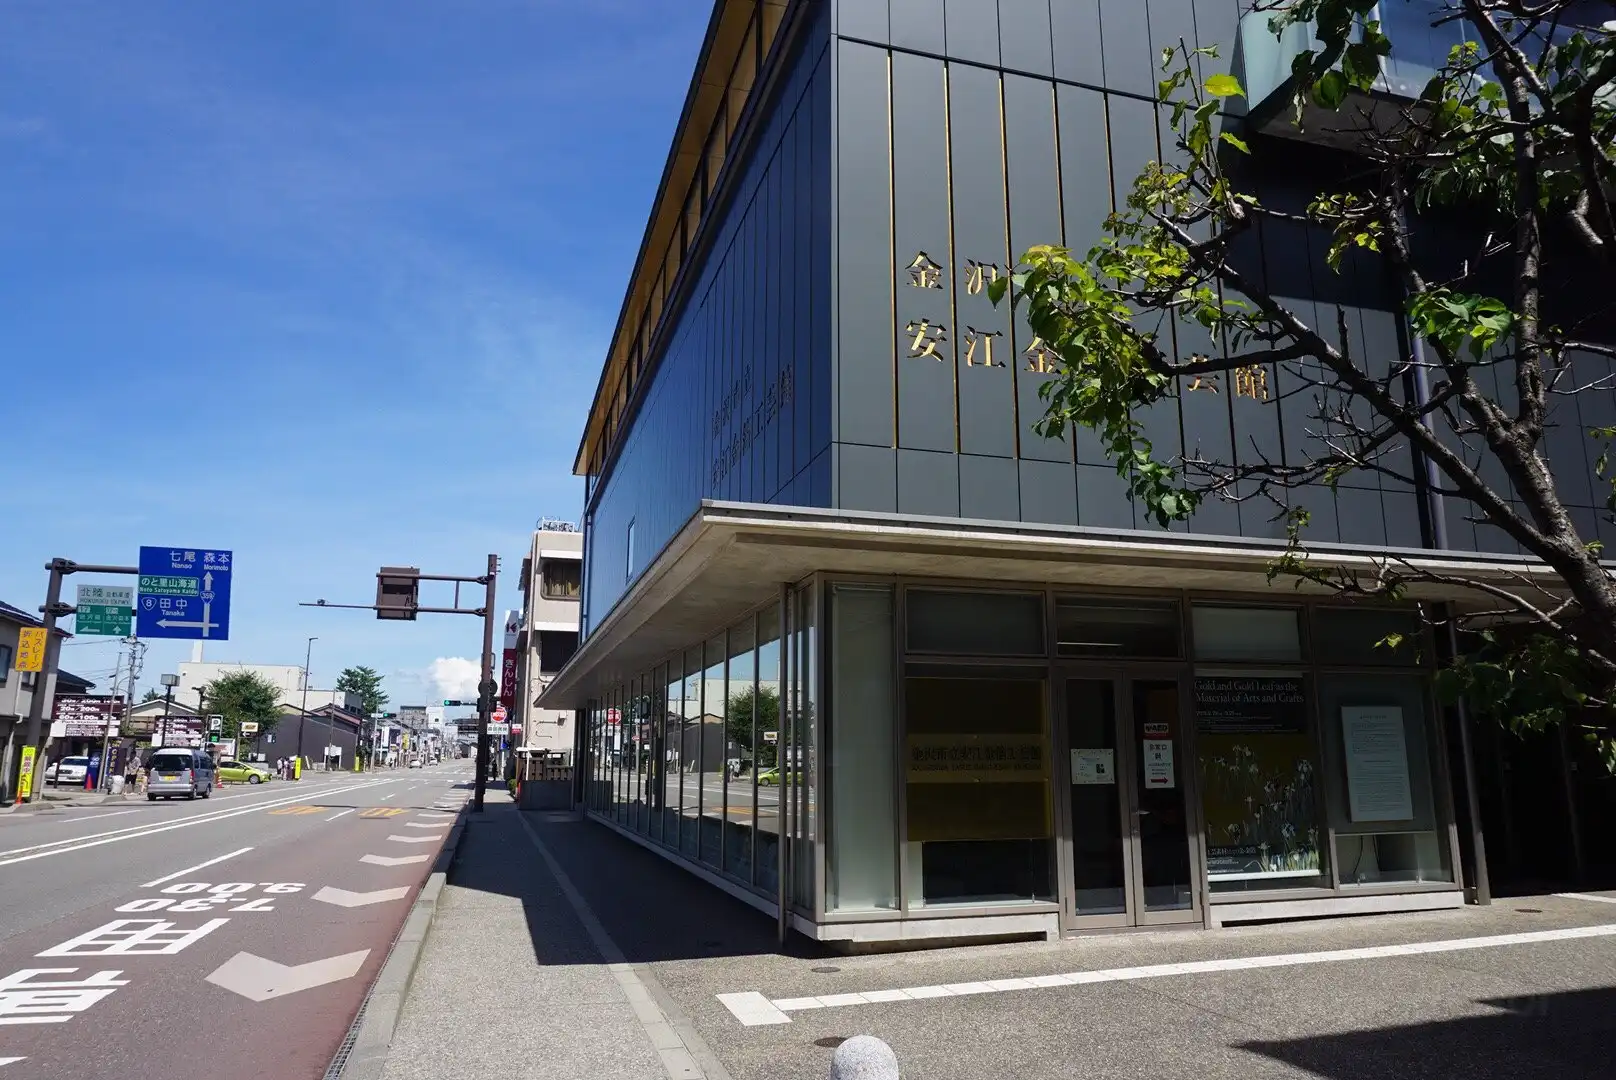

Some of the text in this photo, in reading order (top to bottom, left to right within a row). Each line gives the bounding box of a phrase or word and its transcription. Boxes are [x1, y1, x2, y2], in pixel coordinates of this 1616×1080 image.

[169, 550, 230, 564] 七尾 森本
[141, 577, 197, 588] のと里山海道
[145, 599, 152, 607] 8
[160, 598, 188, 610] 田中
[31, 631, 44, 669] バスレーン
[503, 659, 514, 697] きんしん
[1194, 680, 1216, 691] Gold
[1216, 680, 1232, 691] and
[1234, 680, 1254, 691] Gold
[1256, 680, 1275, 691] Leaf
[1284, 681, 1298, 691] the
[1196, 692, 1305, 703] Material of Arts and Crafts
[210, 718, 221, 730] P
